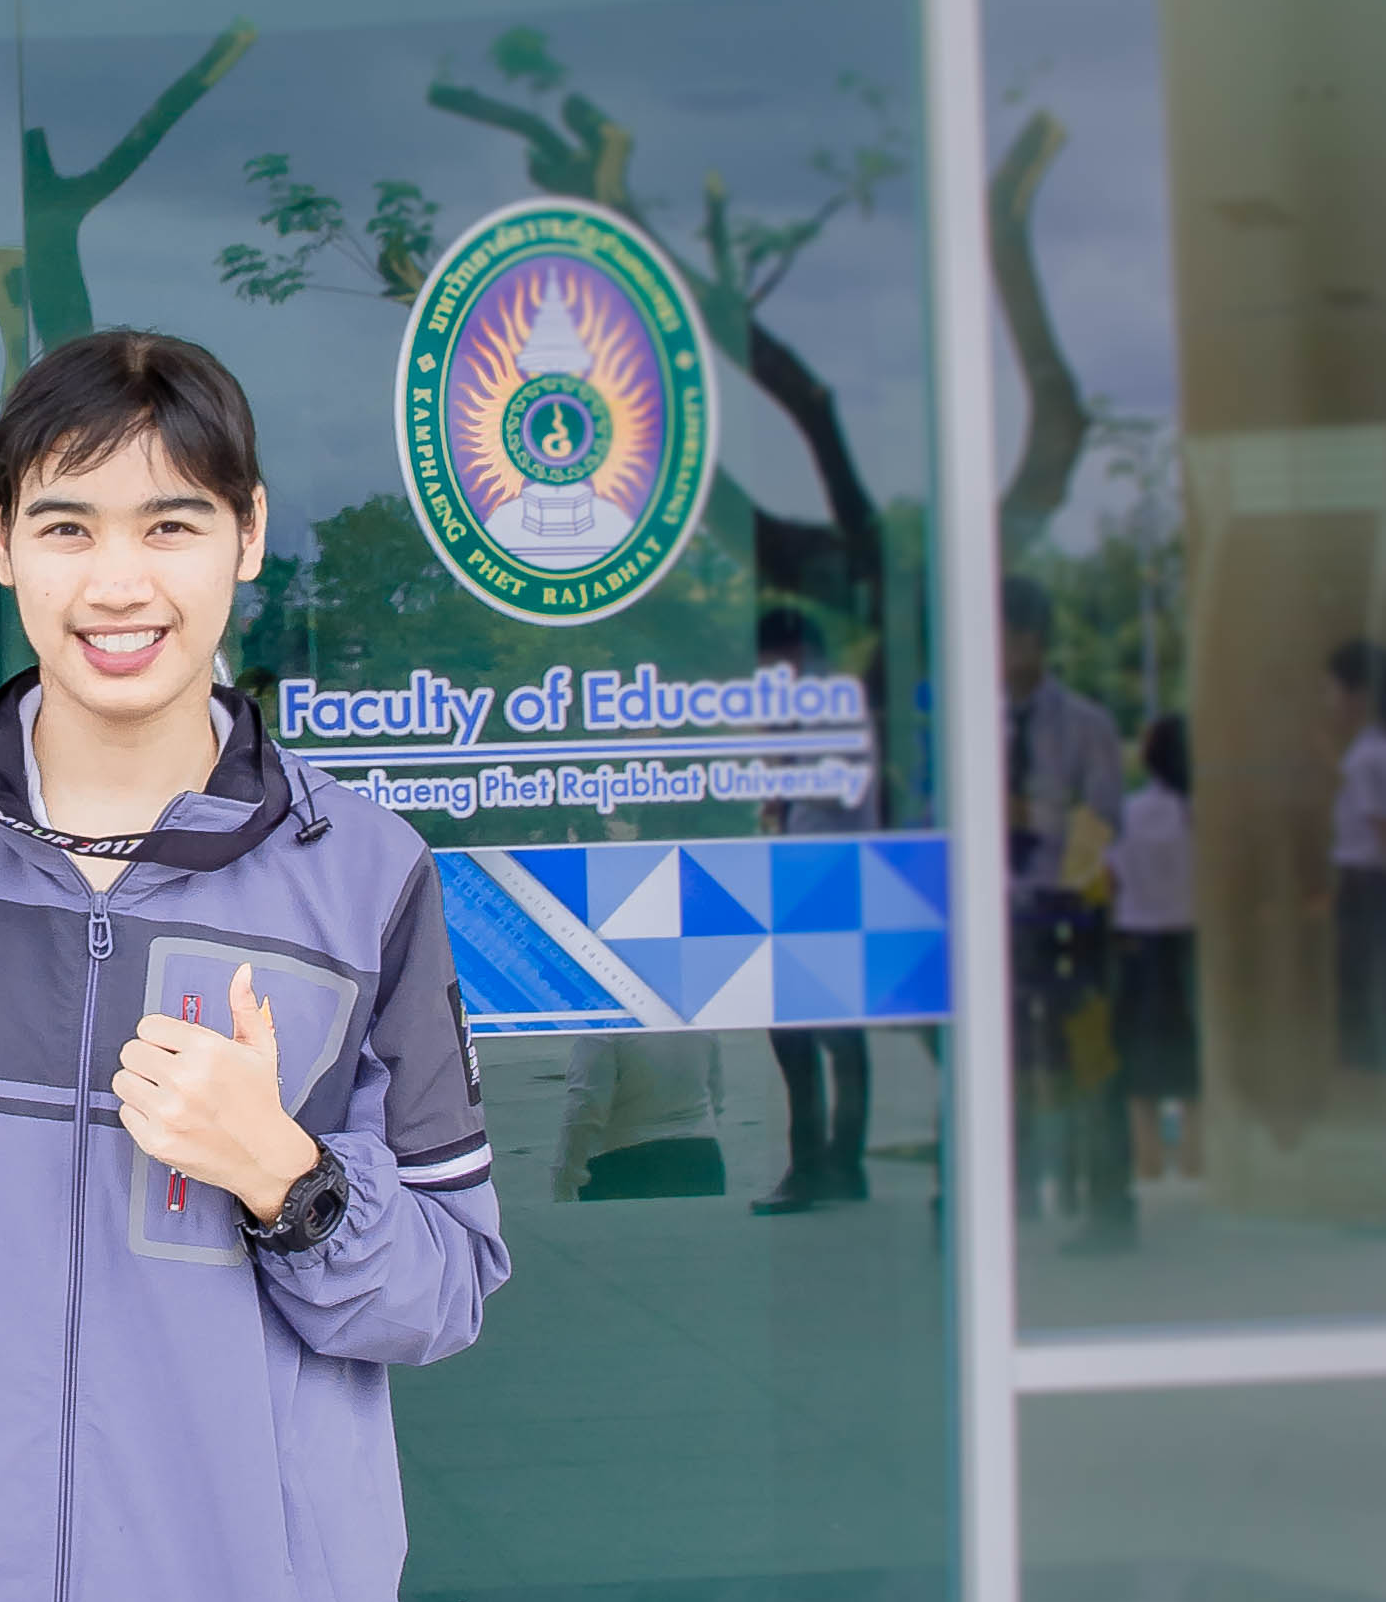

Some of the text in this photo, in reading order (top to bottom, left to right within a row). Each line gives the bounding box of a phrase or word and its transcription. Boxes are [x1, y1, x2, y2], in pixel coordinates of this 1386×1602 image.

[412, 387, 467, 543] KAMPHAENG
[467, 549, 528, 597] PHET
[543, 535, 663, 608] RAJABHAT
[286, 665, 861, 745] Faculty of Education
[485, 771, 550, 803] Phet
[563, 765, 701, 811] Rajabhat
[714, 761, 862, 802] University
[75, 838, 145, 855] 2017
